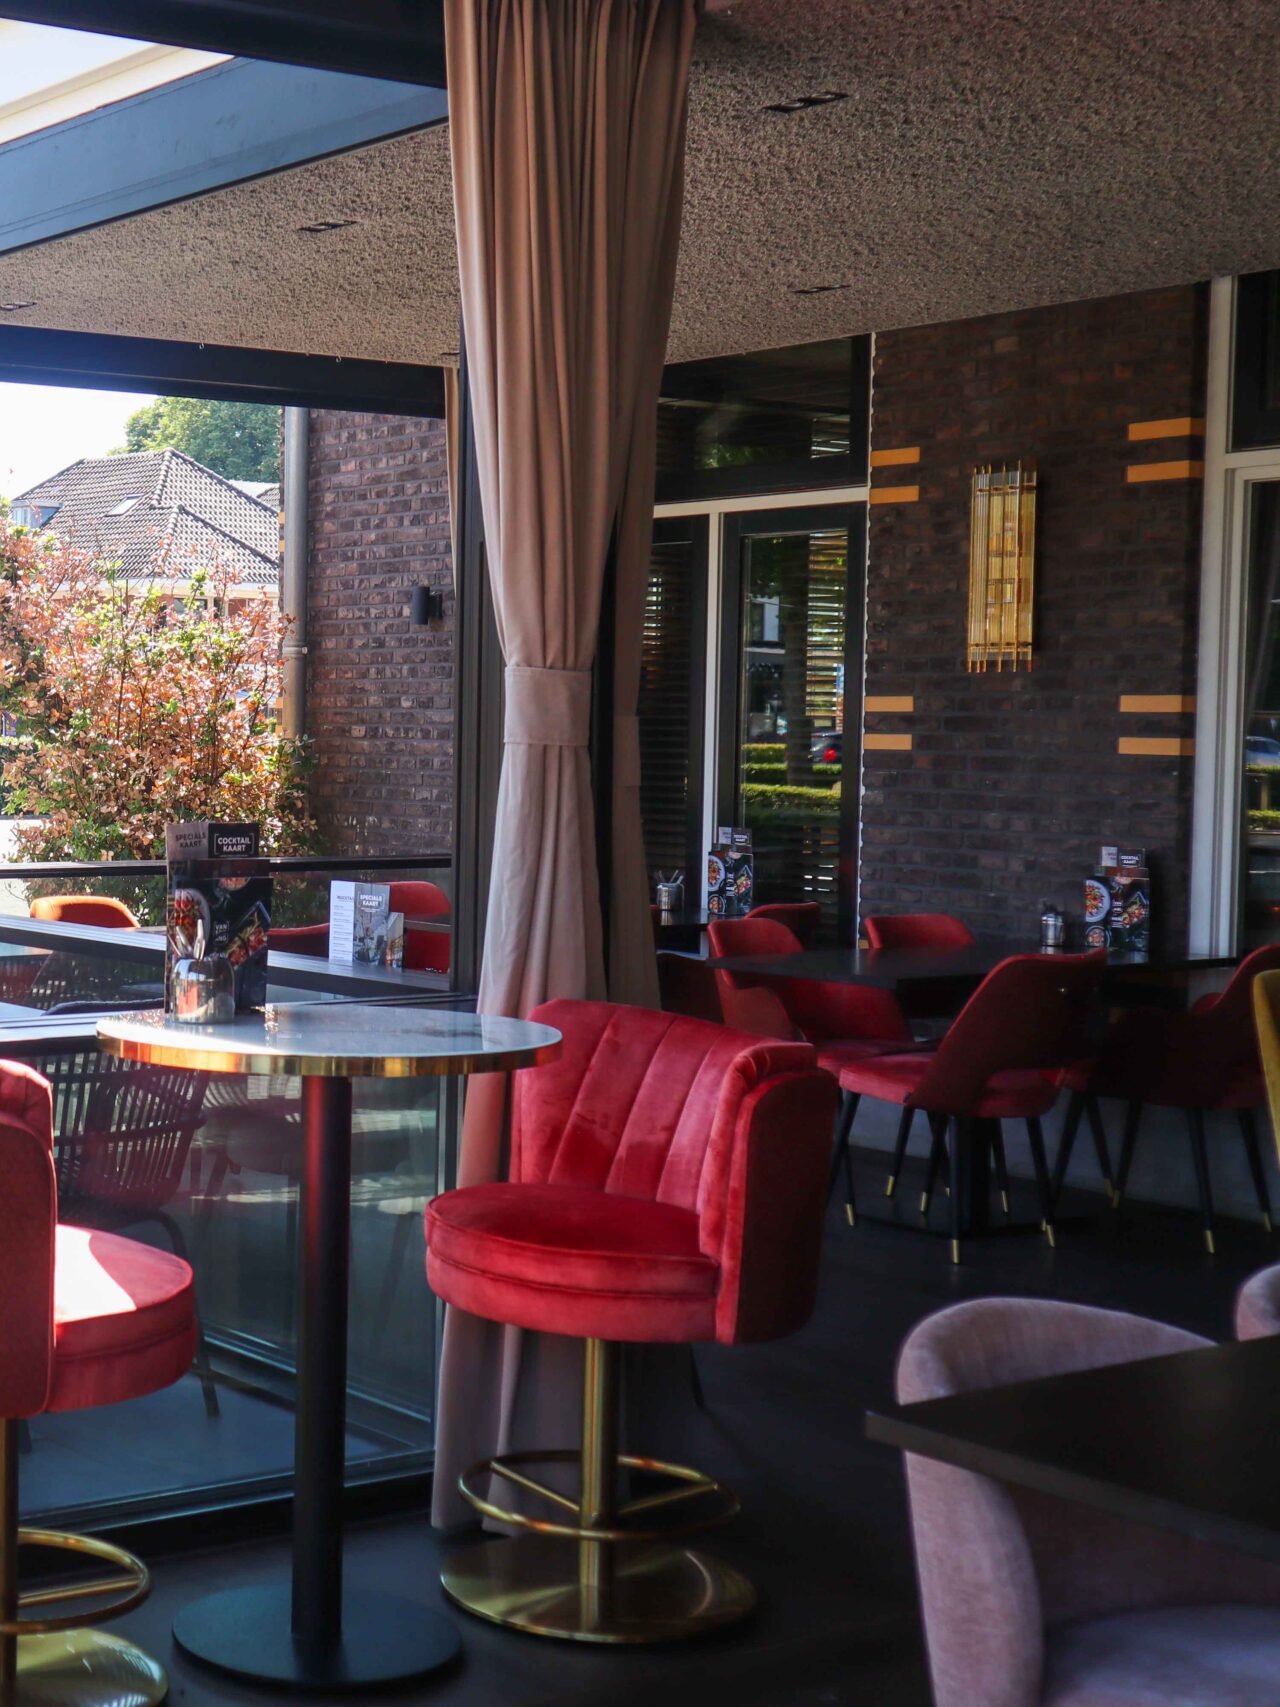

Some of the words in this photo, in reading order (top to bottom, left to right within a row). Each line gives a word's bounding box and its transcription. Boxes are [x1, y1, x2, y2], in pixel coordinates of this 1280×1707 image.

[176, 832, 207, 841] SPECIALS
[180, 841, 201, 849] KAART
[217, 837, 252, 845] COCKTAIL
[360, 894, 383, 902] SPECIALS
